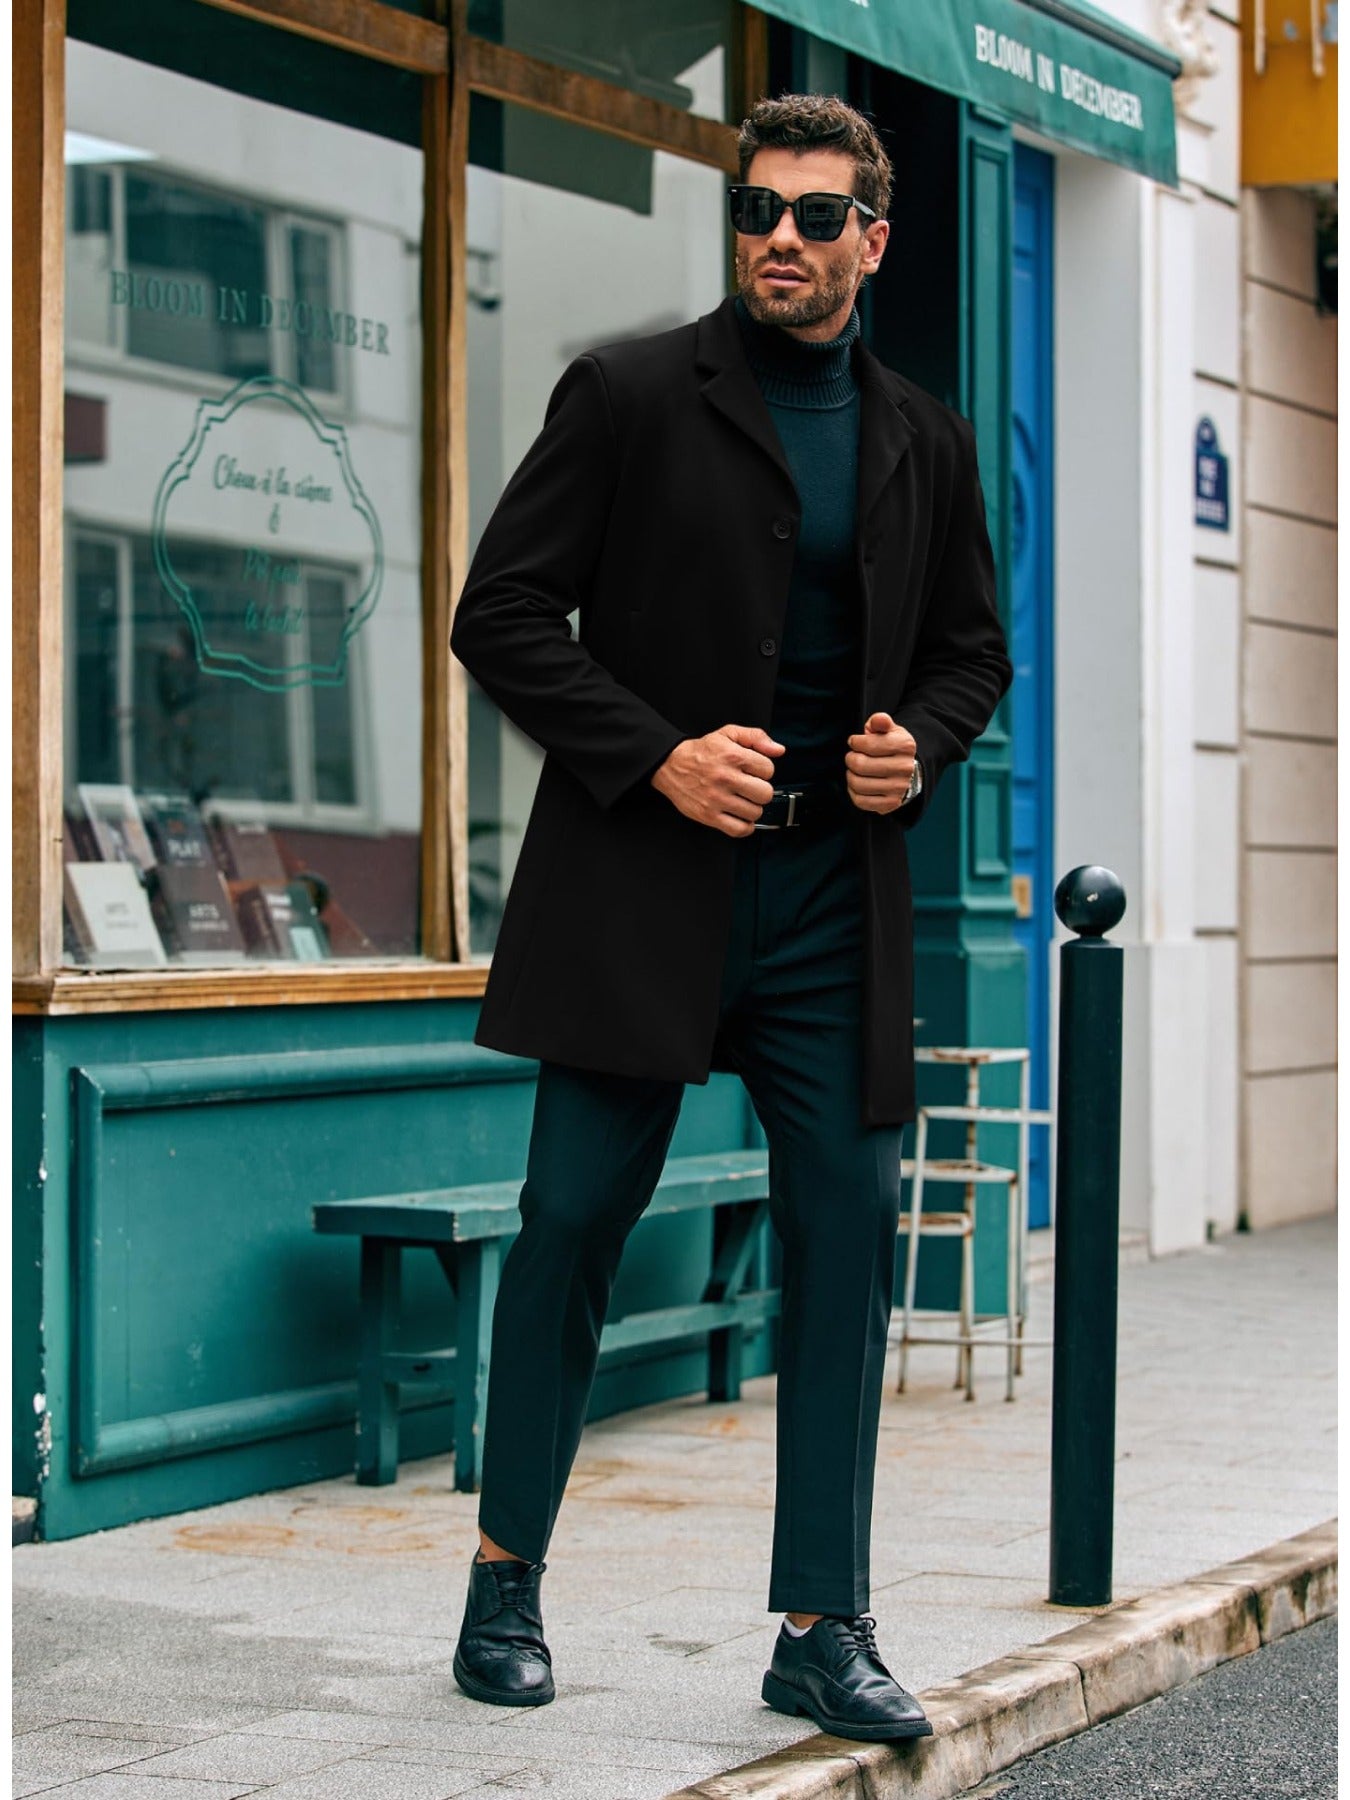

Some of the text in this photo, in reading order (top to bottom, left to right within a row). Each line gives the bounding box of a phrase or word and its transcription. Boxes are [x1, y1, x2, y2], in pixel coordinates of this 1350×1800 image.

[974, 23, 1145, 131] BLOOM IN DECEMBER
[111, 270, 391, 355] BLOOM IN DECEMBER
